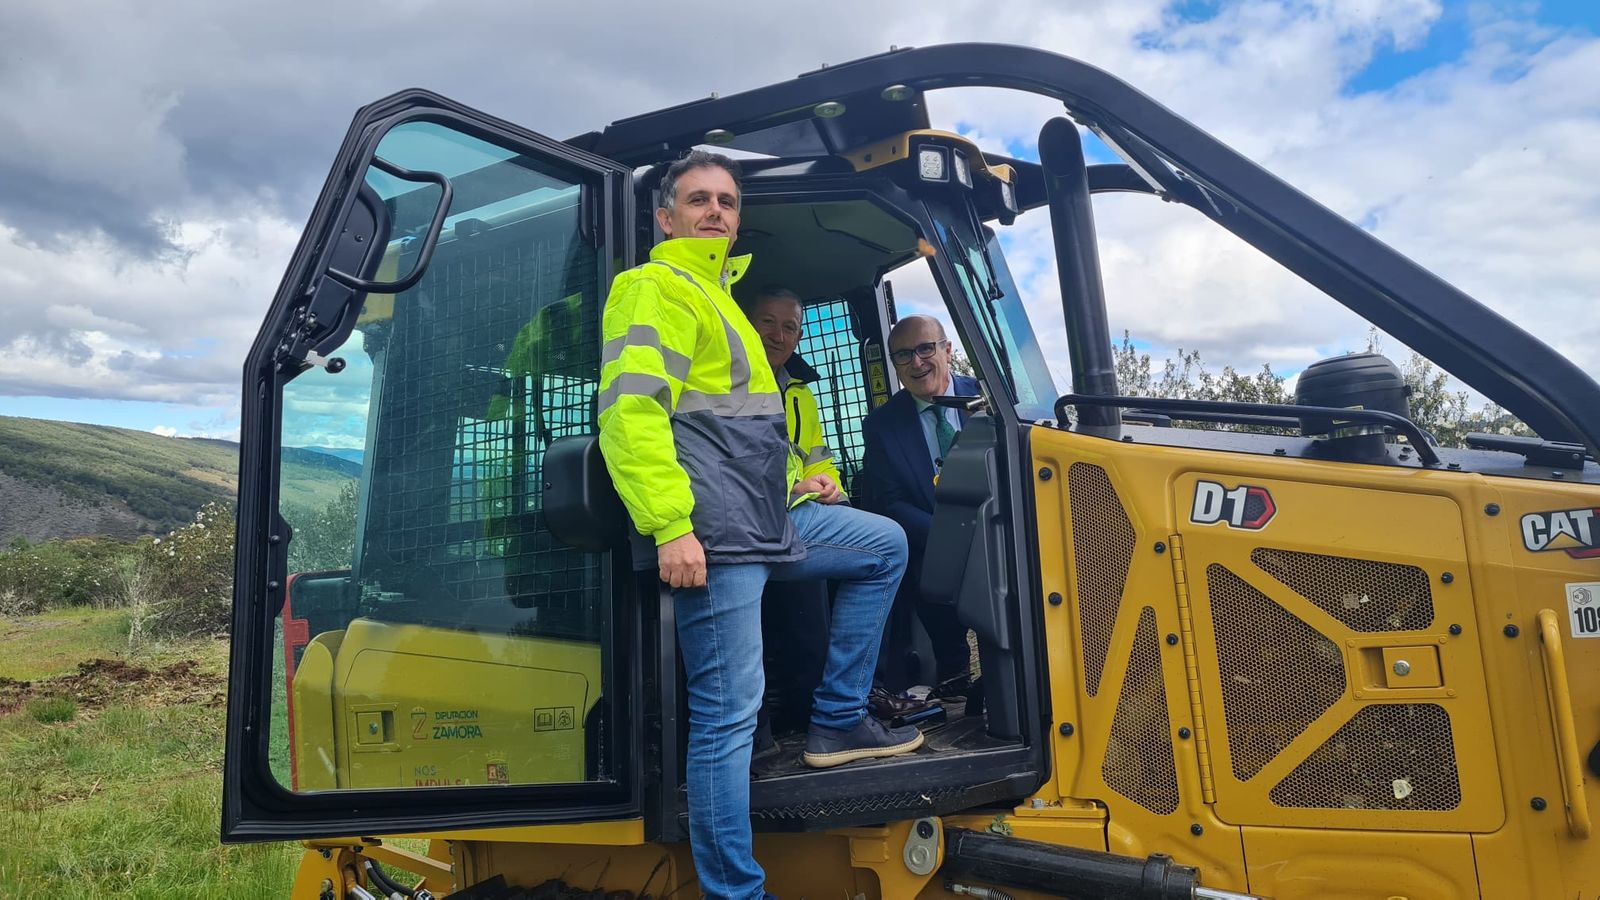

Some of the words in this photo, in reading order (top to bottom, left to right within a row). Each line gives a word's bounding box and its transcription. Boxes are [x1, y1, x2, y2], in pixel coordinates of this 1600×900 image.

[1192, 480, 1248, 526] D1
[1521, 509, 1594, 551] CAT
[1574, 606, 1600, 633] 10
[432, 725, 483, 740] ZAMORA
[414, 765, 437, 776] NOS
